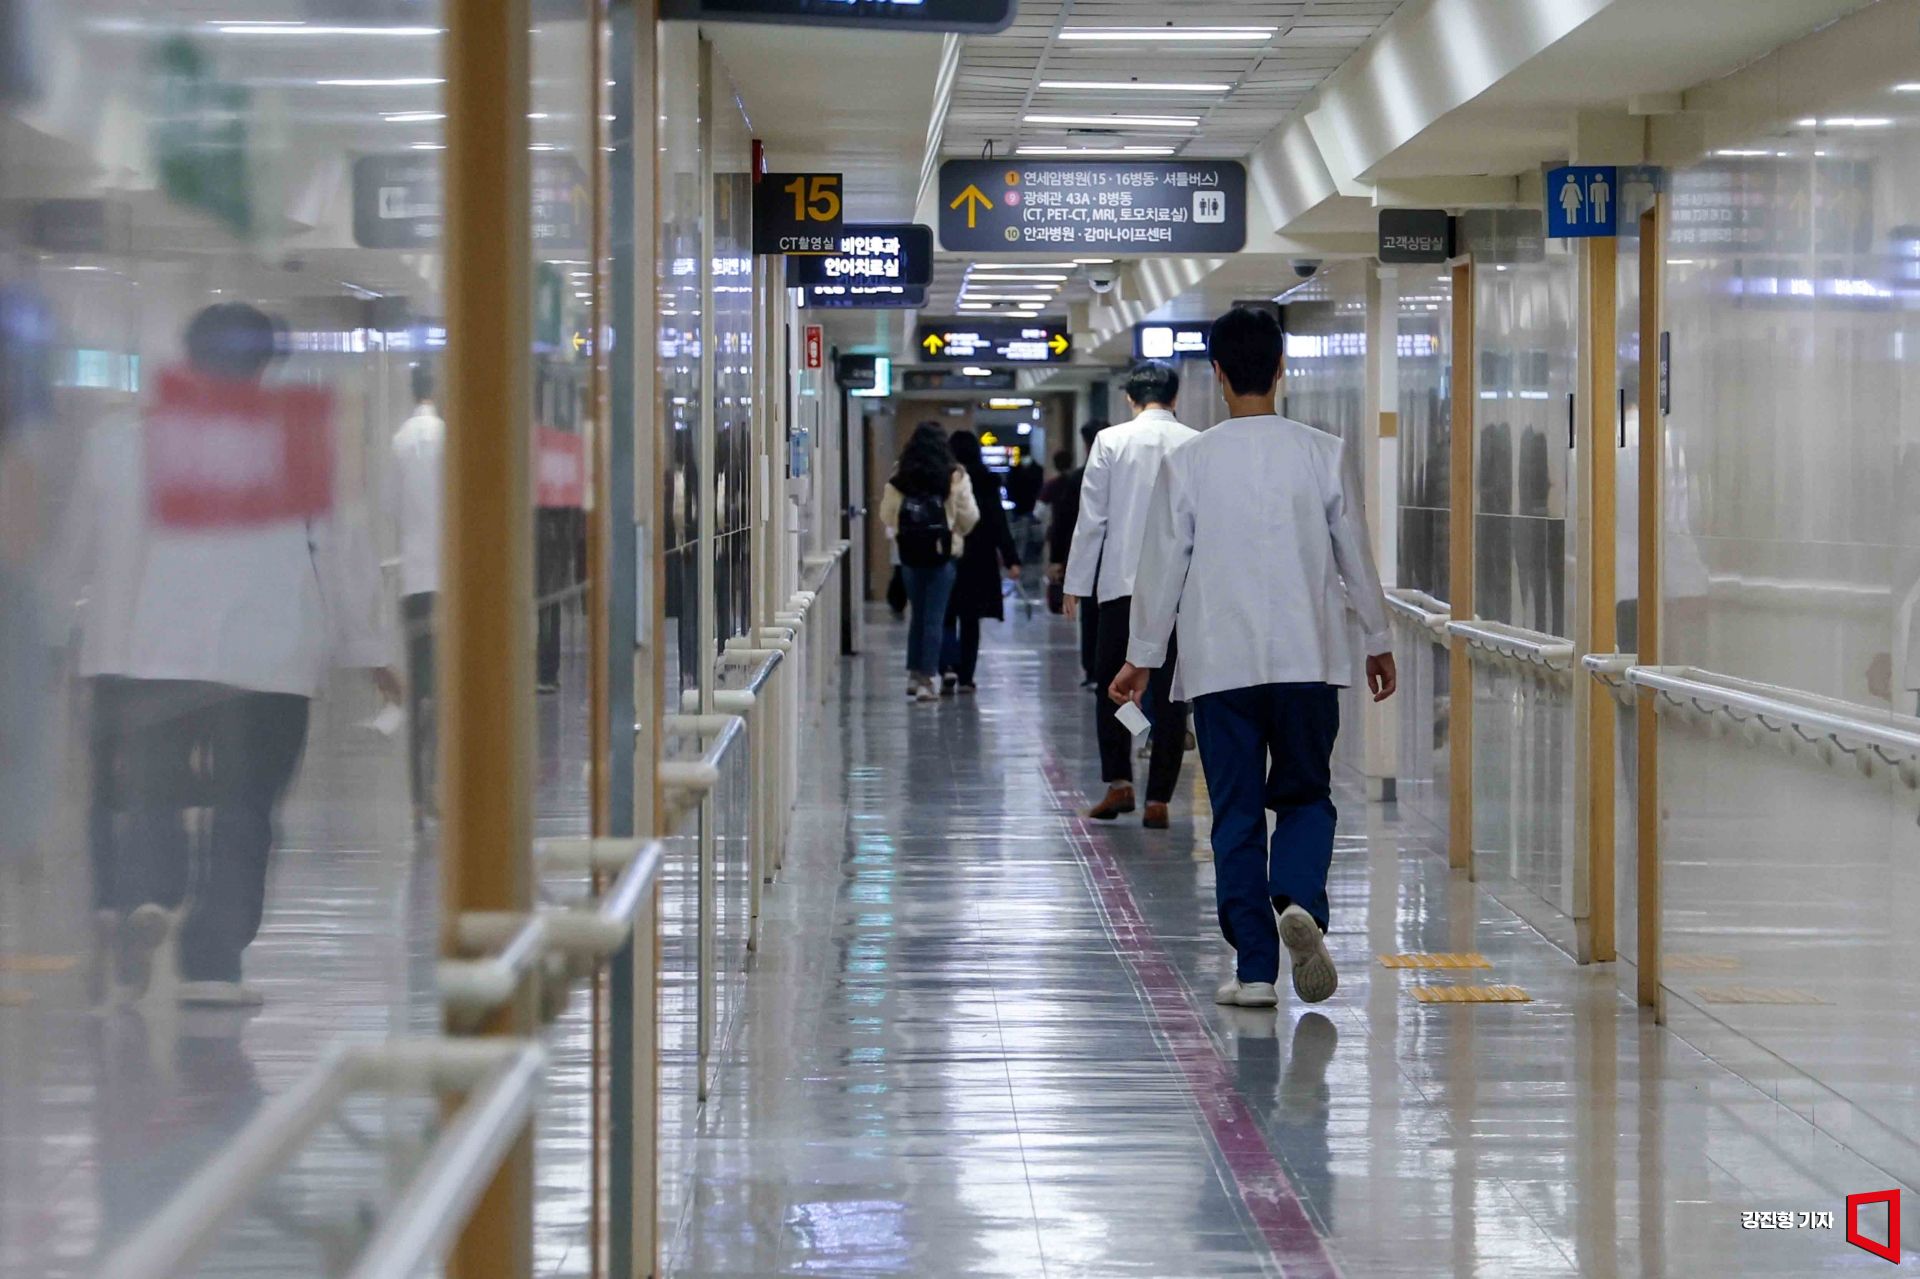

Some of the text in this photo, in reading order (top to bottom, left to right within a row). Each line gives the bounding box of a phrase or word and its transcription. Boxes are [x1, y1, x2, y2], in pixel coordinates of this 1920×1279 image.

[1163, 171, 1219, 187] 셔틀버스)
[784, 177, 841, 222] 15
[1023, 191, 1062, 206] 광혜관
[1023, 207, 1188, 223] (CT, PET-CT, MRI, 토모치료실)
[1024, 227, 1075, 242] 안과병원
[1084, 227, 1172, 242] 감마나이프센터
[779, 237, 835, 250] CT촬영실
[1383, 236, 1444, 251] 고객상담실
[824, 257, 900, 277] 언어치료실
